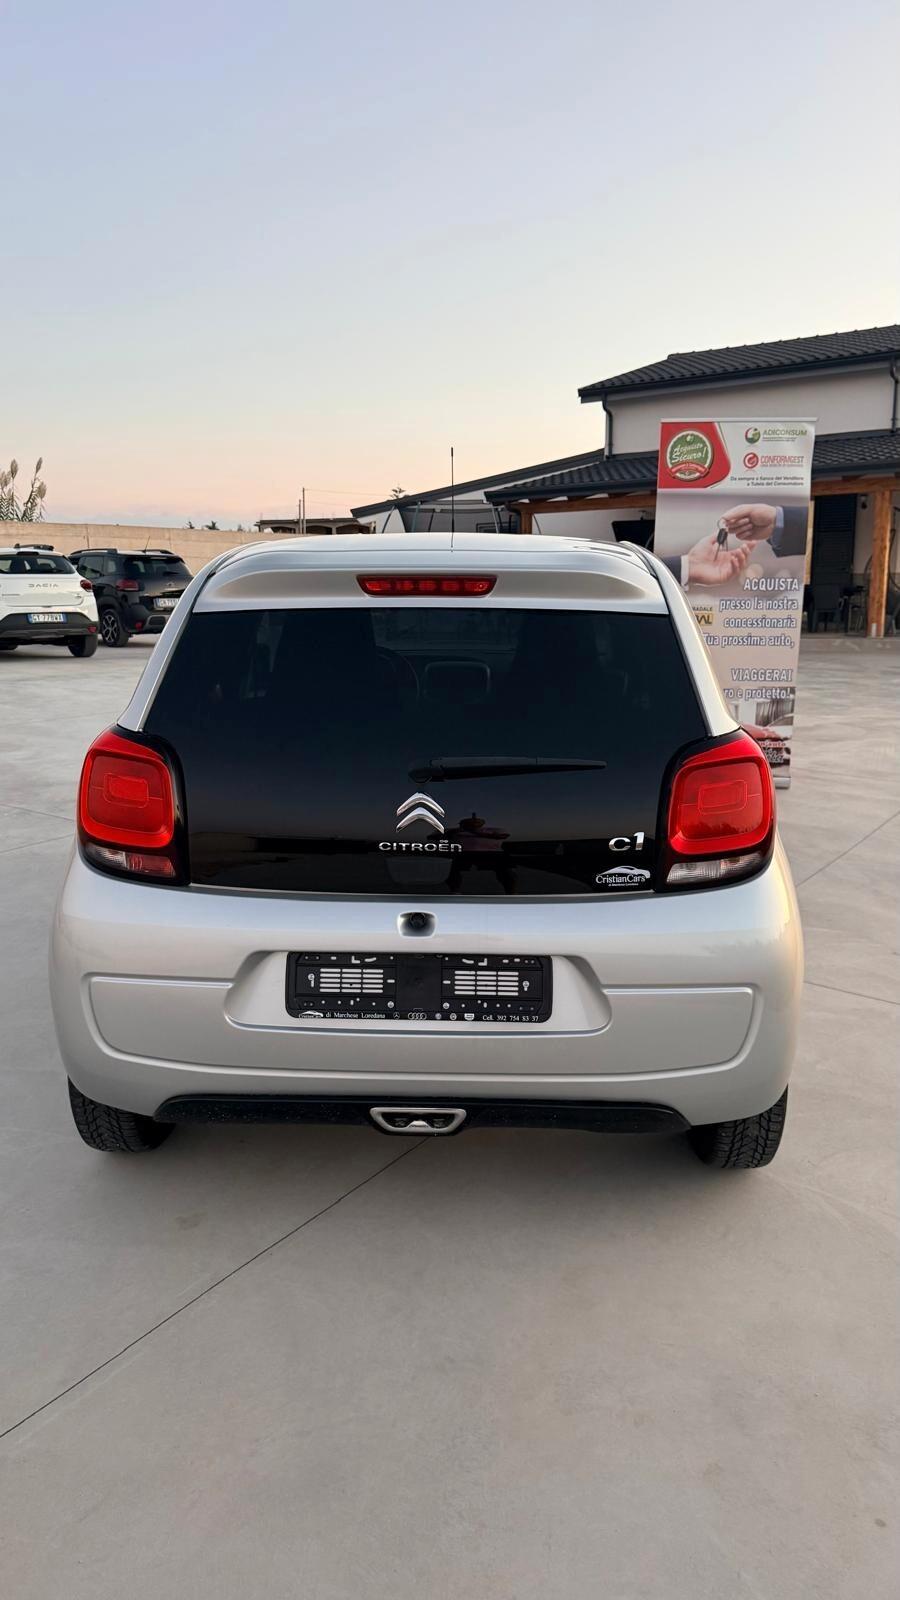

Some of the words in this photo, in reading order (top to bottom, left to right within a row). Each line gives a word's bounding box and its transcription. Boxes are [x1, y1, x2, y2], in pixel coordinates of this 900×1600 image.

[671, 446, 707, 463] Sicuro!
[743, 577, 799, 591] ACQUISTA
[719, 598, 751, 612] presso
[753, 596, 764, 610] la
[765, 596, 798, 610] nostra
[723, 614, 796, 629] concessionaria
[704, 633, 720, 646] Tua
[721, 632, 766, 648] prossima
[766, 633, 795, 648] auto,
[731, 668, 793, 682] VIAGGERAI
[724, 688, 734, 699] ro
[737, 689, 744, 699] e
[745, 687, 791, 701] protetto!
[595, 874, 646, 884] CristianCars
[333, 1011, 359, 1019] Marchese
